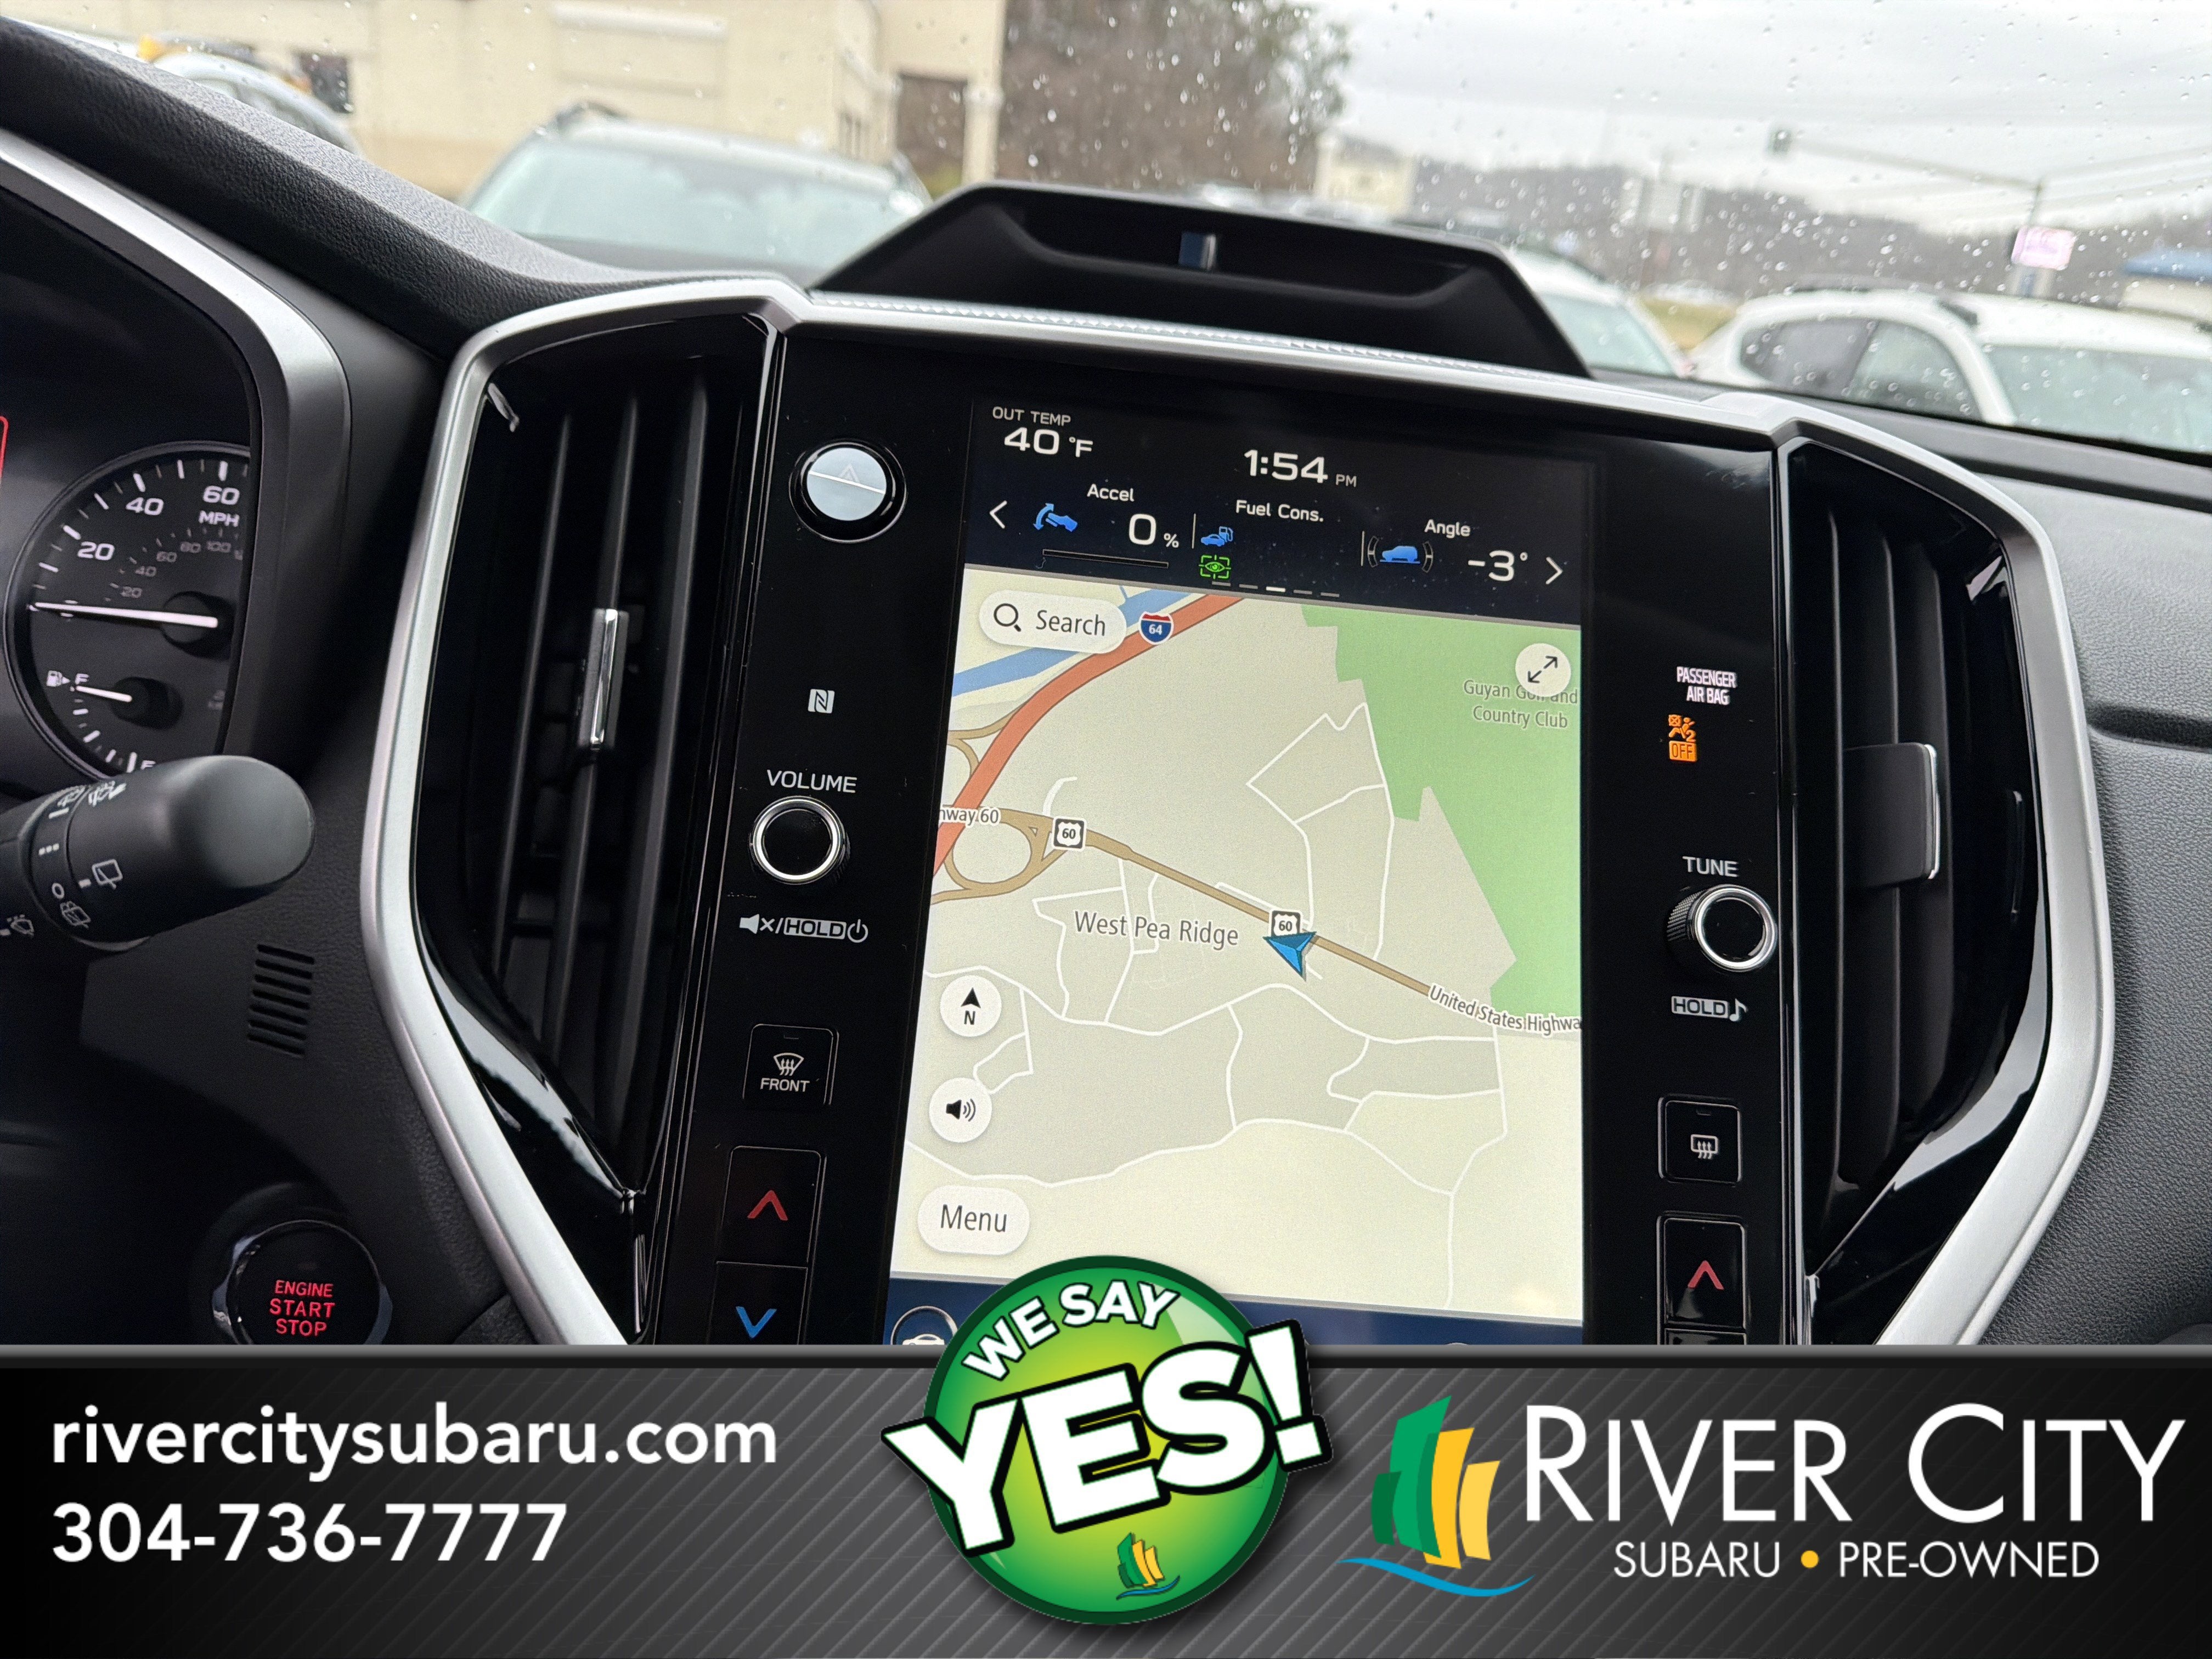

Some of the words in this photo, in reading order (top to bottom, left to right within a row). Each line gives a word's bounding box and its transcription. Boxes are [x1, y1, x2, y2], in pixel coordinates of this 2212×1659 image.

[992, 406, 1025, 421] OUT
[1030, 411, 1071, 426] TEMP
[1004, 427, 1060, 455] 40
[1244, 449, 1328, 483] 1:54
[1335, 473, 1357, 487] PM
[203, 486, 240, 505] 60
[1087, 483, 1135, 502] Accel
[126, 497, 164, 515] 40
[1235, 499, 1271, 517] Fuel
[1278, 504, 1323, 522] Cons.
[199, 510, 240, 527] MPH
[1424, 519, 1471, 538] Angle
[1128, 514, 1156, 545] 0
[1164, 533, 1179, 548] %
[77, 541, 115, 561] 20
[135, 566, 156, 577] 40
[1036, 610, 1106, 636] Search
[1148, 624, 1163, 635] 64
[75, 673, 89, 685] F
[1677, 666, 1737, 689] PASSENGER
[1464, 680, 1510, 701] Guyan
[1686, 685, 1705, 703] AIR
[1707, 687, 1730, 706] BAG
[1473, 706, 1530, 729] Country
[1536, 711, 1568, 728] Club
[1672, 742, 1693, 759] OFF
[766, 769, 857, 793] VOLUME
[980, 808, 1000, 824] 60
[1062, 828, 1076, 839] 60
[1682, 856, 1737, 877] TUNE
[1074, 910, 1127, 936] West
[1135, 916, 1170, 939] Pea
[1180, 920, 1239, 950] Ridge
[1278, 921, 1293, 932] 60
[1430, 985, 1476, 1016] United
[1479, 1006, 1523, 1030] States
[1673, 997, 1728, 1017] HOLD
[964, 1011, 975, 1025] N
[760, 1077, 810, 1092] FRONT
[940, 1204, 1007, 1233] Menu
[274, 1279, 334, 1298] ENGINE
[269, 1298, 335, 1318] START
[275, 1318, 328, 1337] STOP
